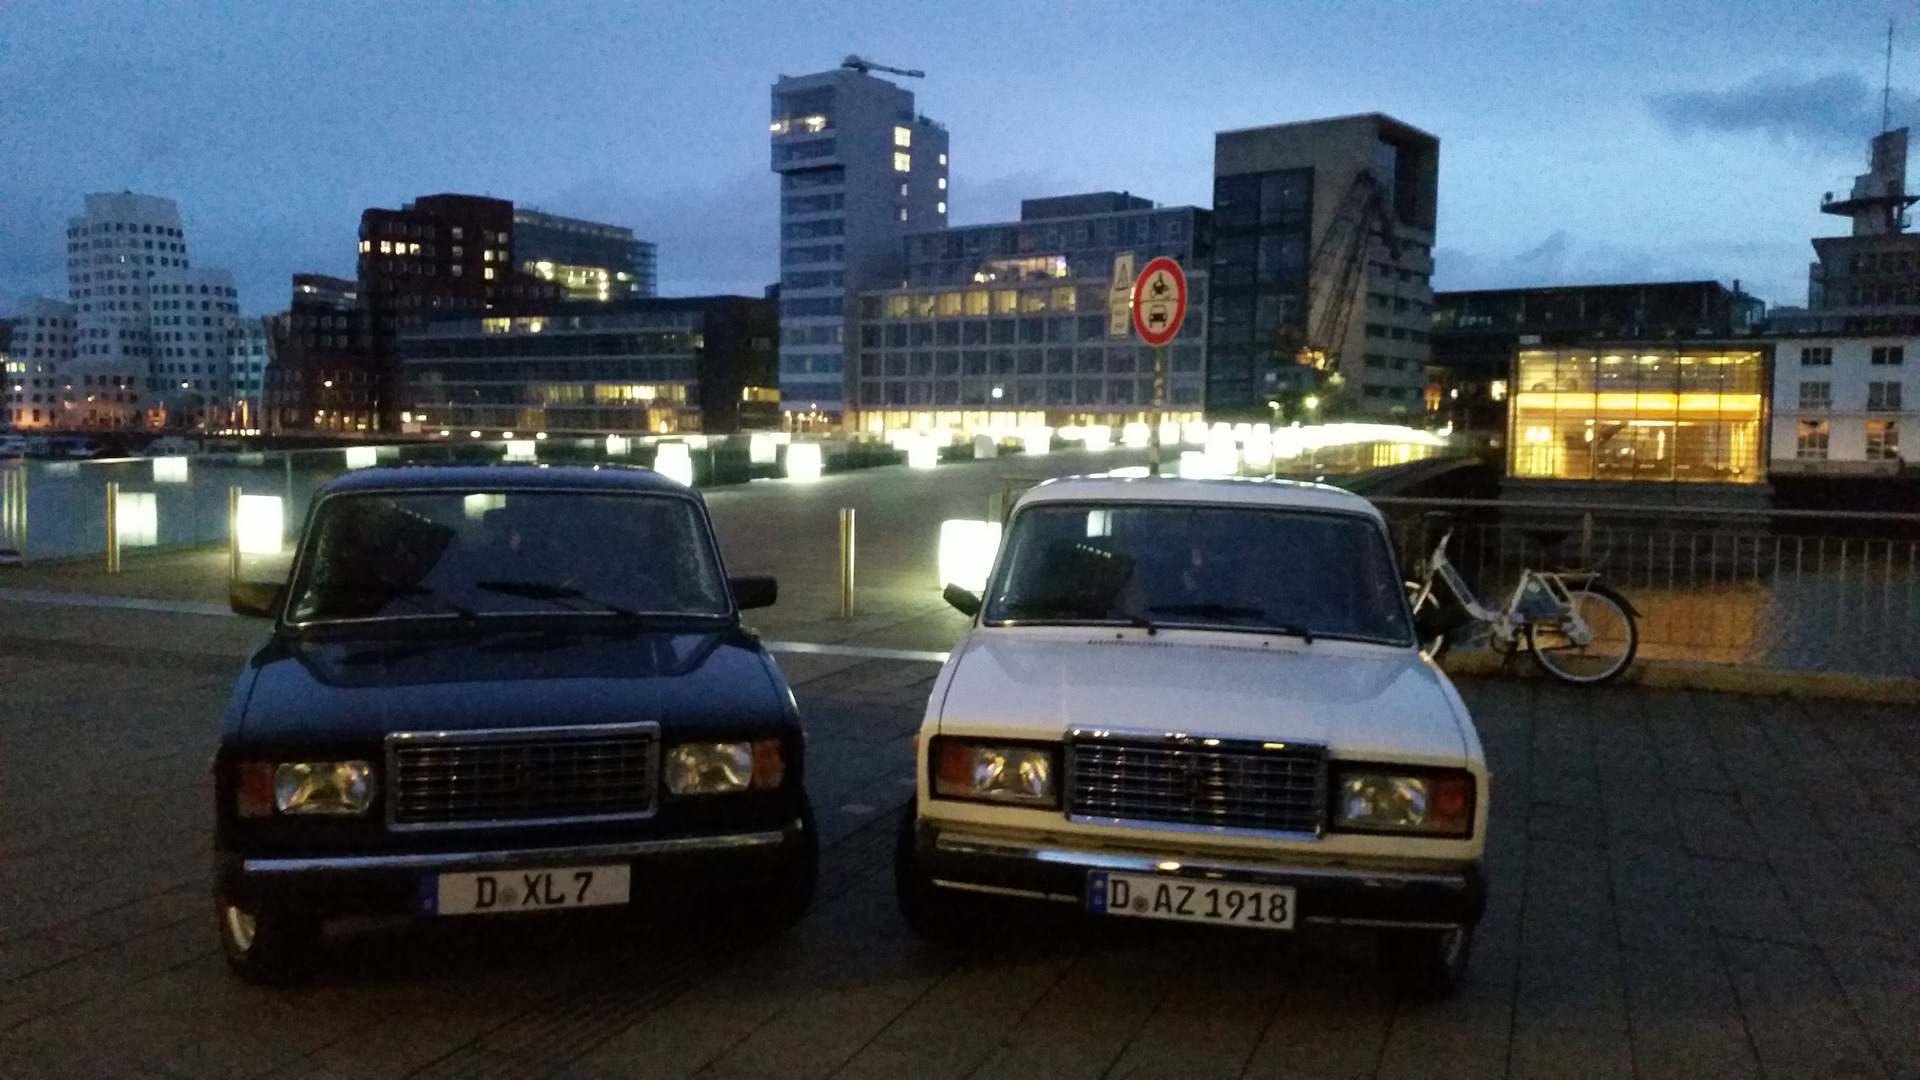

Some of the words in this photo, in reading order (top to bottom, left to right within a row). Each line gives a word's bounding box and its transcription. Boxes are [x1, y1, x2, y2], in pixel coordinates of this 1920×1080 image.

[475, 876, 497, 908] D
[522, 873, 566, 905] XL
[574, 871, 594, 903] 7
[1110, 879, 1130, 909] D
[1153, 883, 1196, 915] AZ
[1204, 888, 1288, 923] 1918
